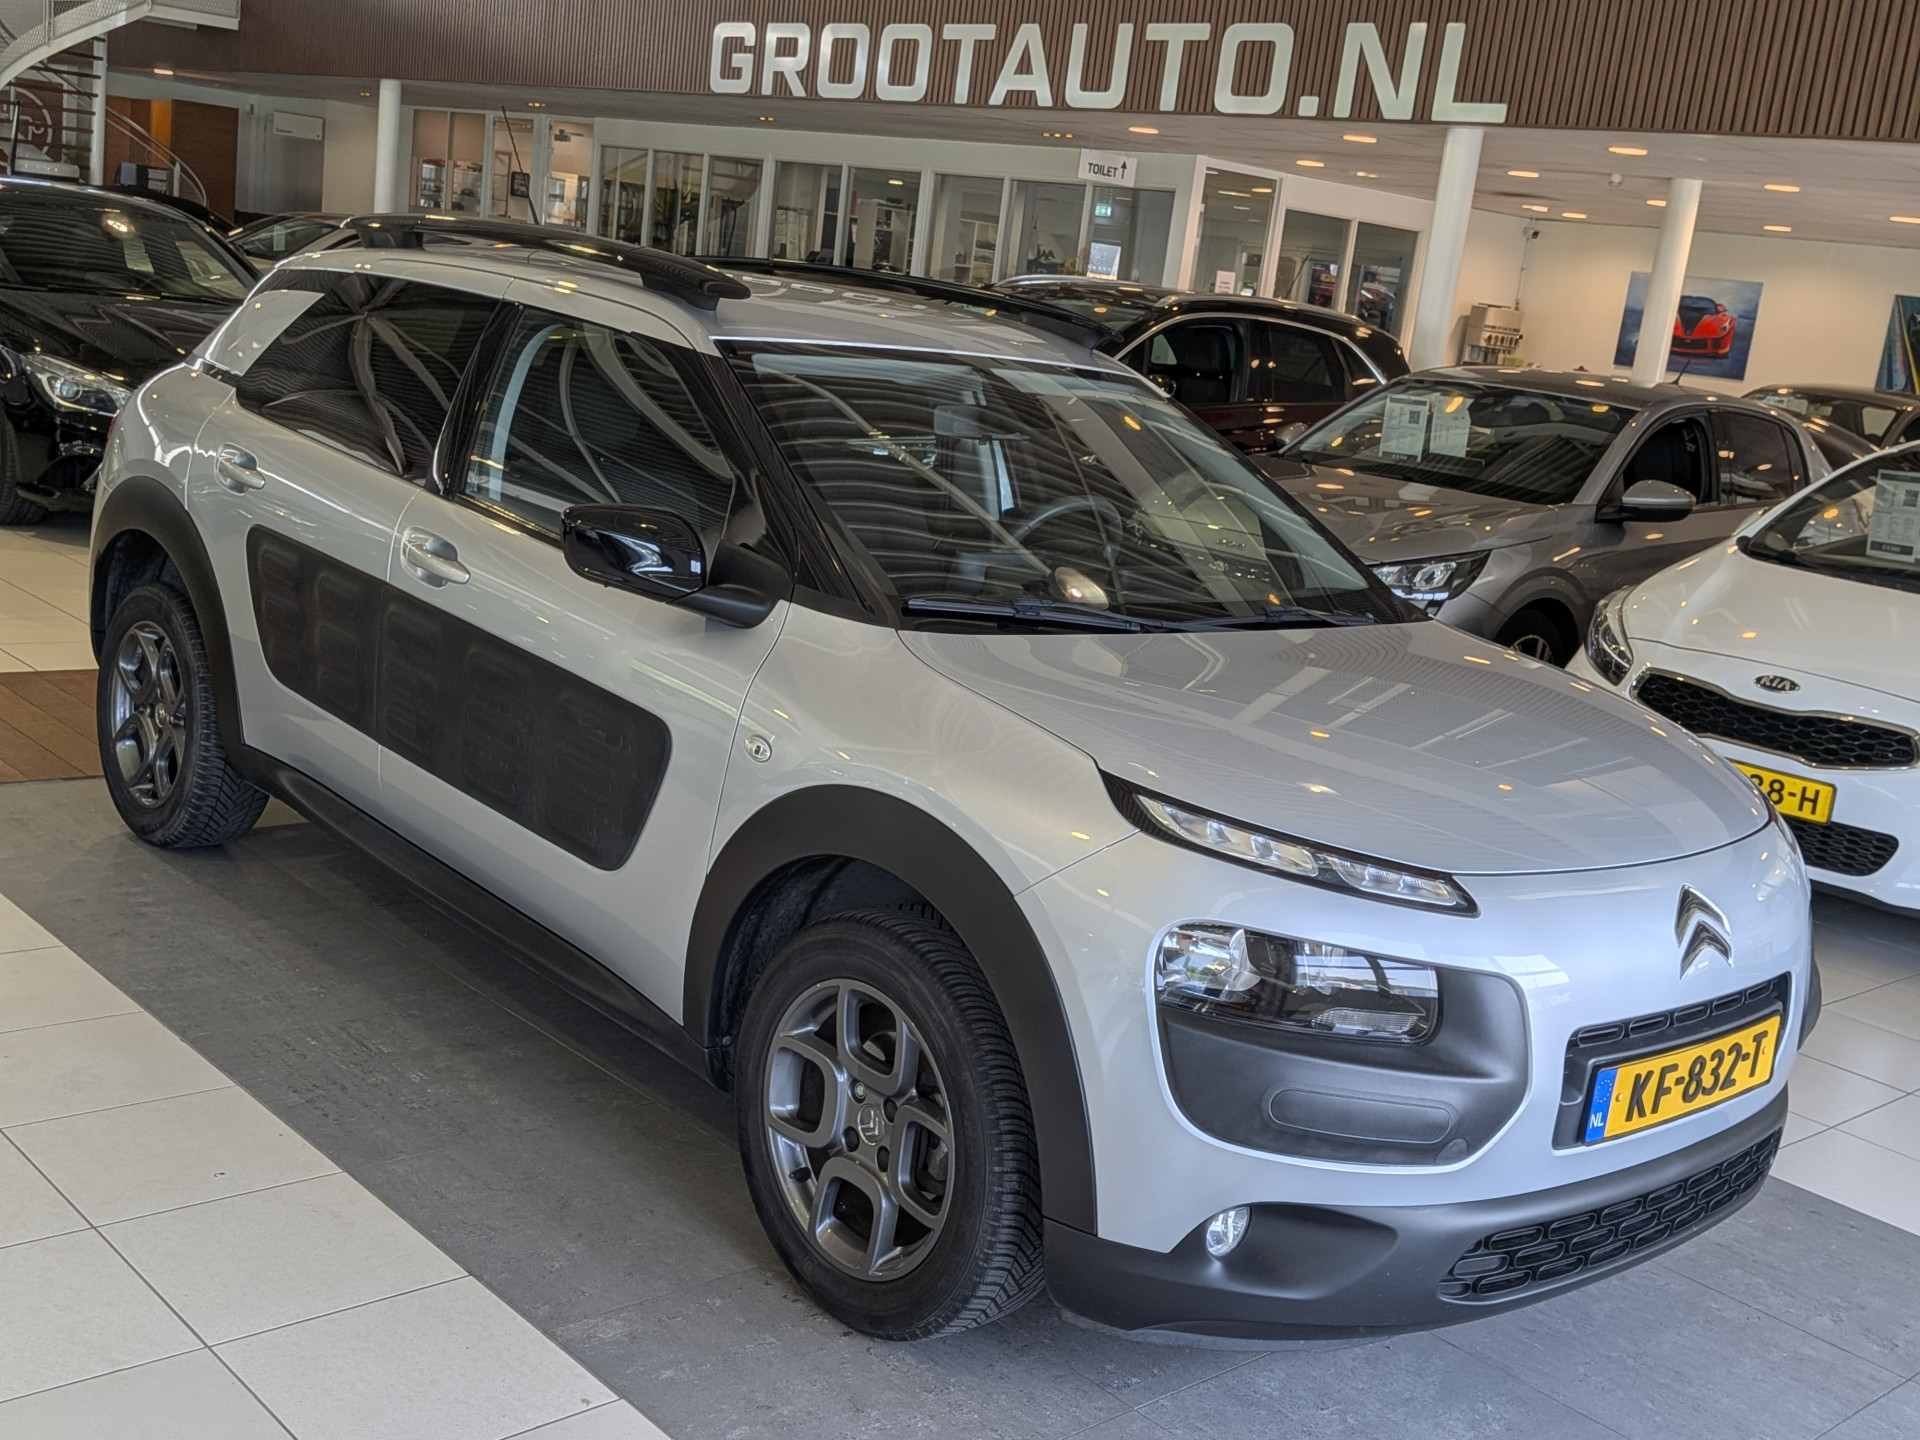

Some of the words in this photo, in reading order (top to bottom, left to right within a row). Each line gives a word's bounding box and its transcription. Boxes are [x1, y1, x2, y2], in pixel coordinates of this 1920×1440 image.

[709, 22, 1508, 124] GROOTAUTO.NL
[1088, 162, 1119, 178] TOILET
[1760, 676, 1791, 691] KIA
[1625, 1029, 1769, 1122] KF-832-T
[1589, 1112, 1604, 1129] NL
